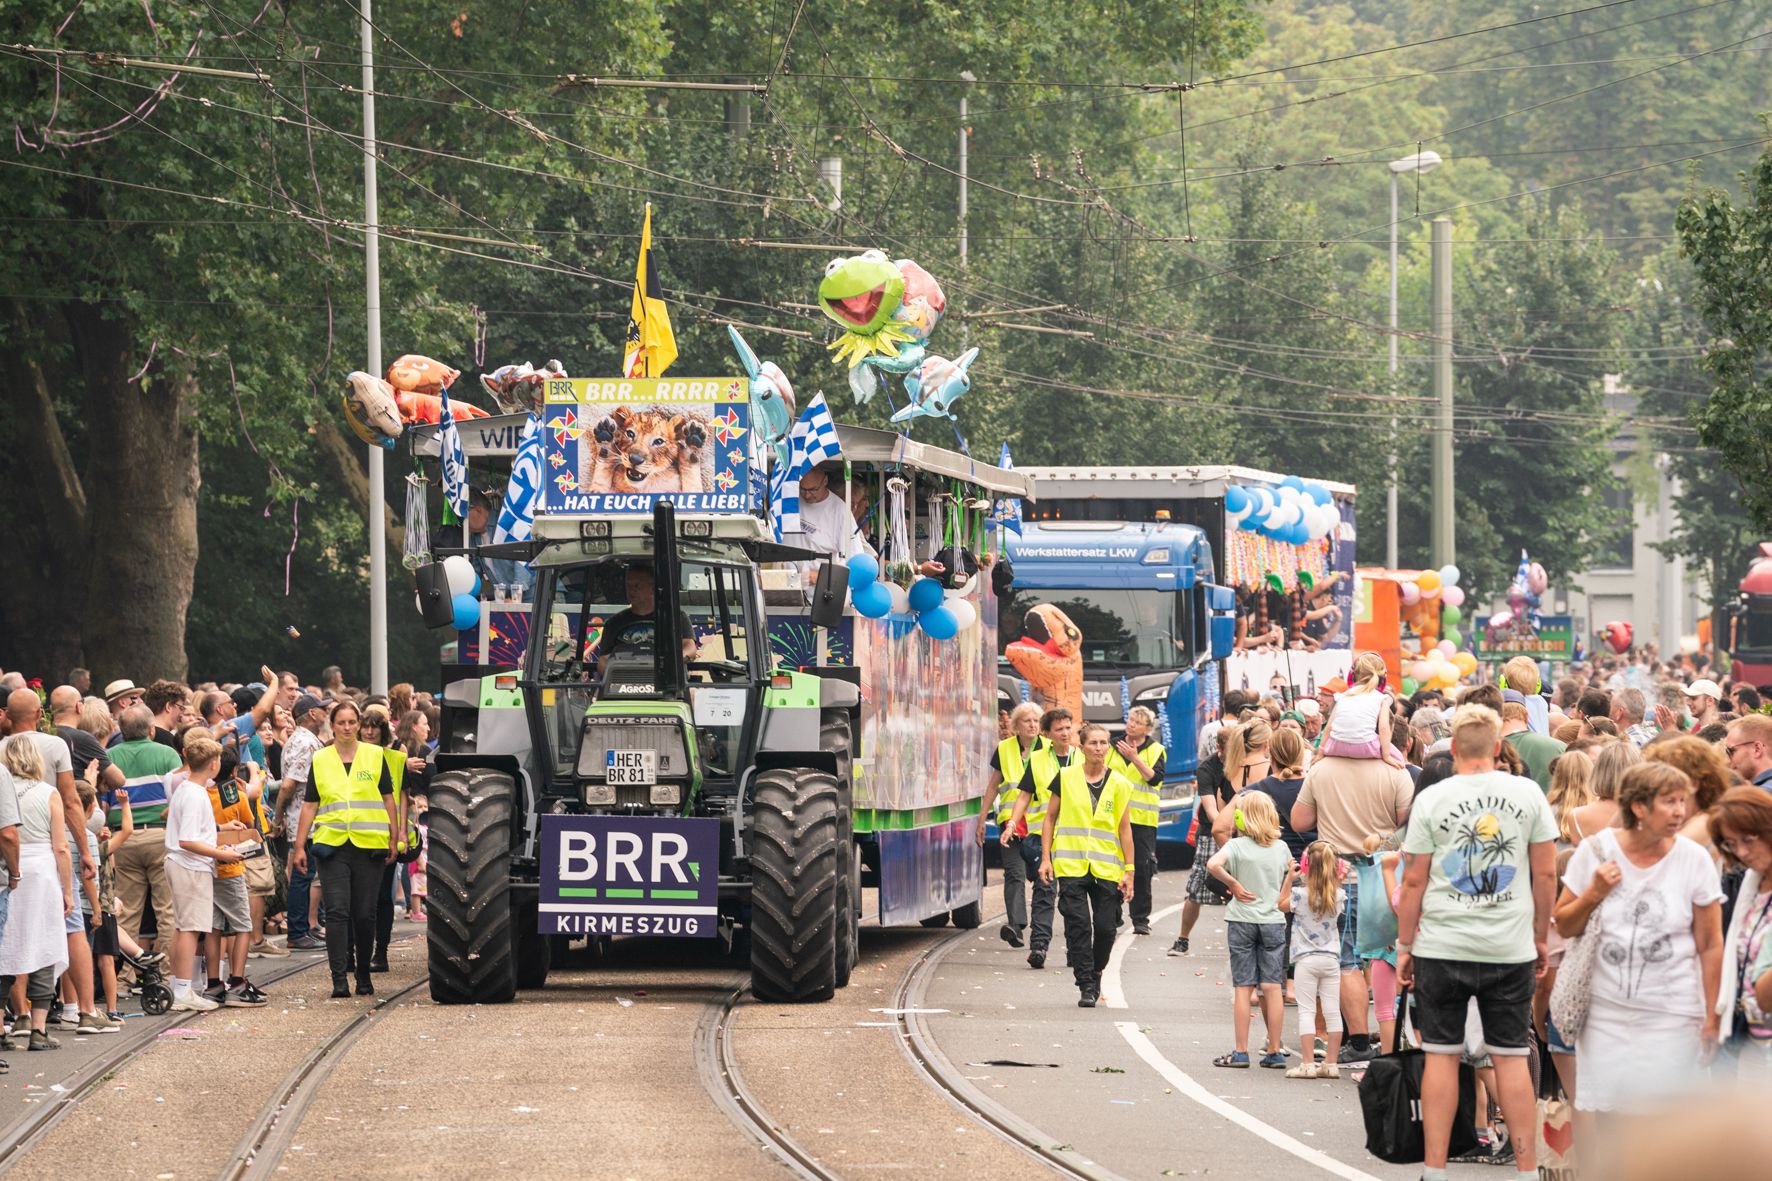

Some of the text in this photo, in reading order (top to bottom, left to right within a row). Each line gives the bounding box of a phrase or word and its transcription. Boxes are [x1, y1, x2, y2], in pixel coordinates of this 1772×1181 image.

[549, 381, 578, 401] BRR
[603, 494, 652, 510] EUCH
[701, 494, 746, 509] LIEB!
[1015, 547, 1138, 558] Werkstattersatz LKW
[616, 753, 643, 767] HER
[608, 768, 626, 782] BR
[629, 768, 645, 782] 81
[1440, 796, 1528, 833] PARADISE
[558, 830, 690, 883] BRR
[1448, 890, 1513, 903] SUMMER
[556, 914, 700, 935] KIRMESZUG
